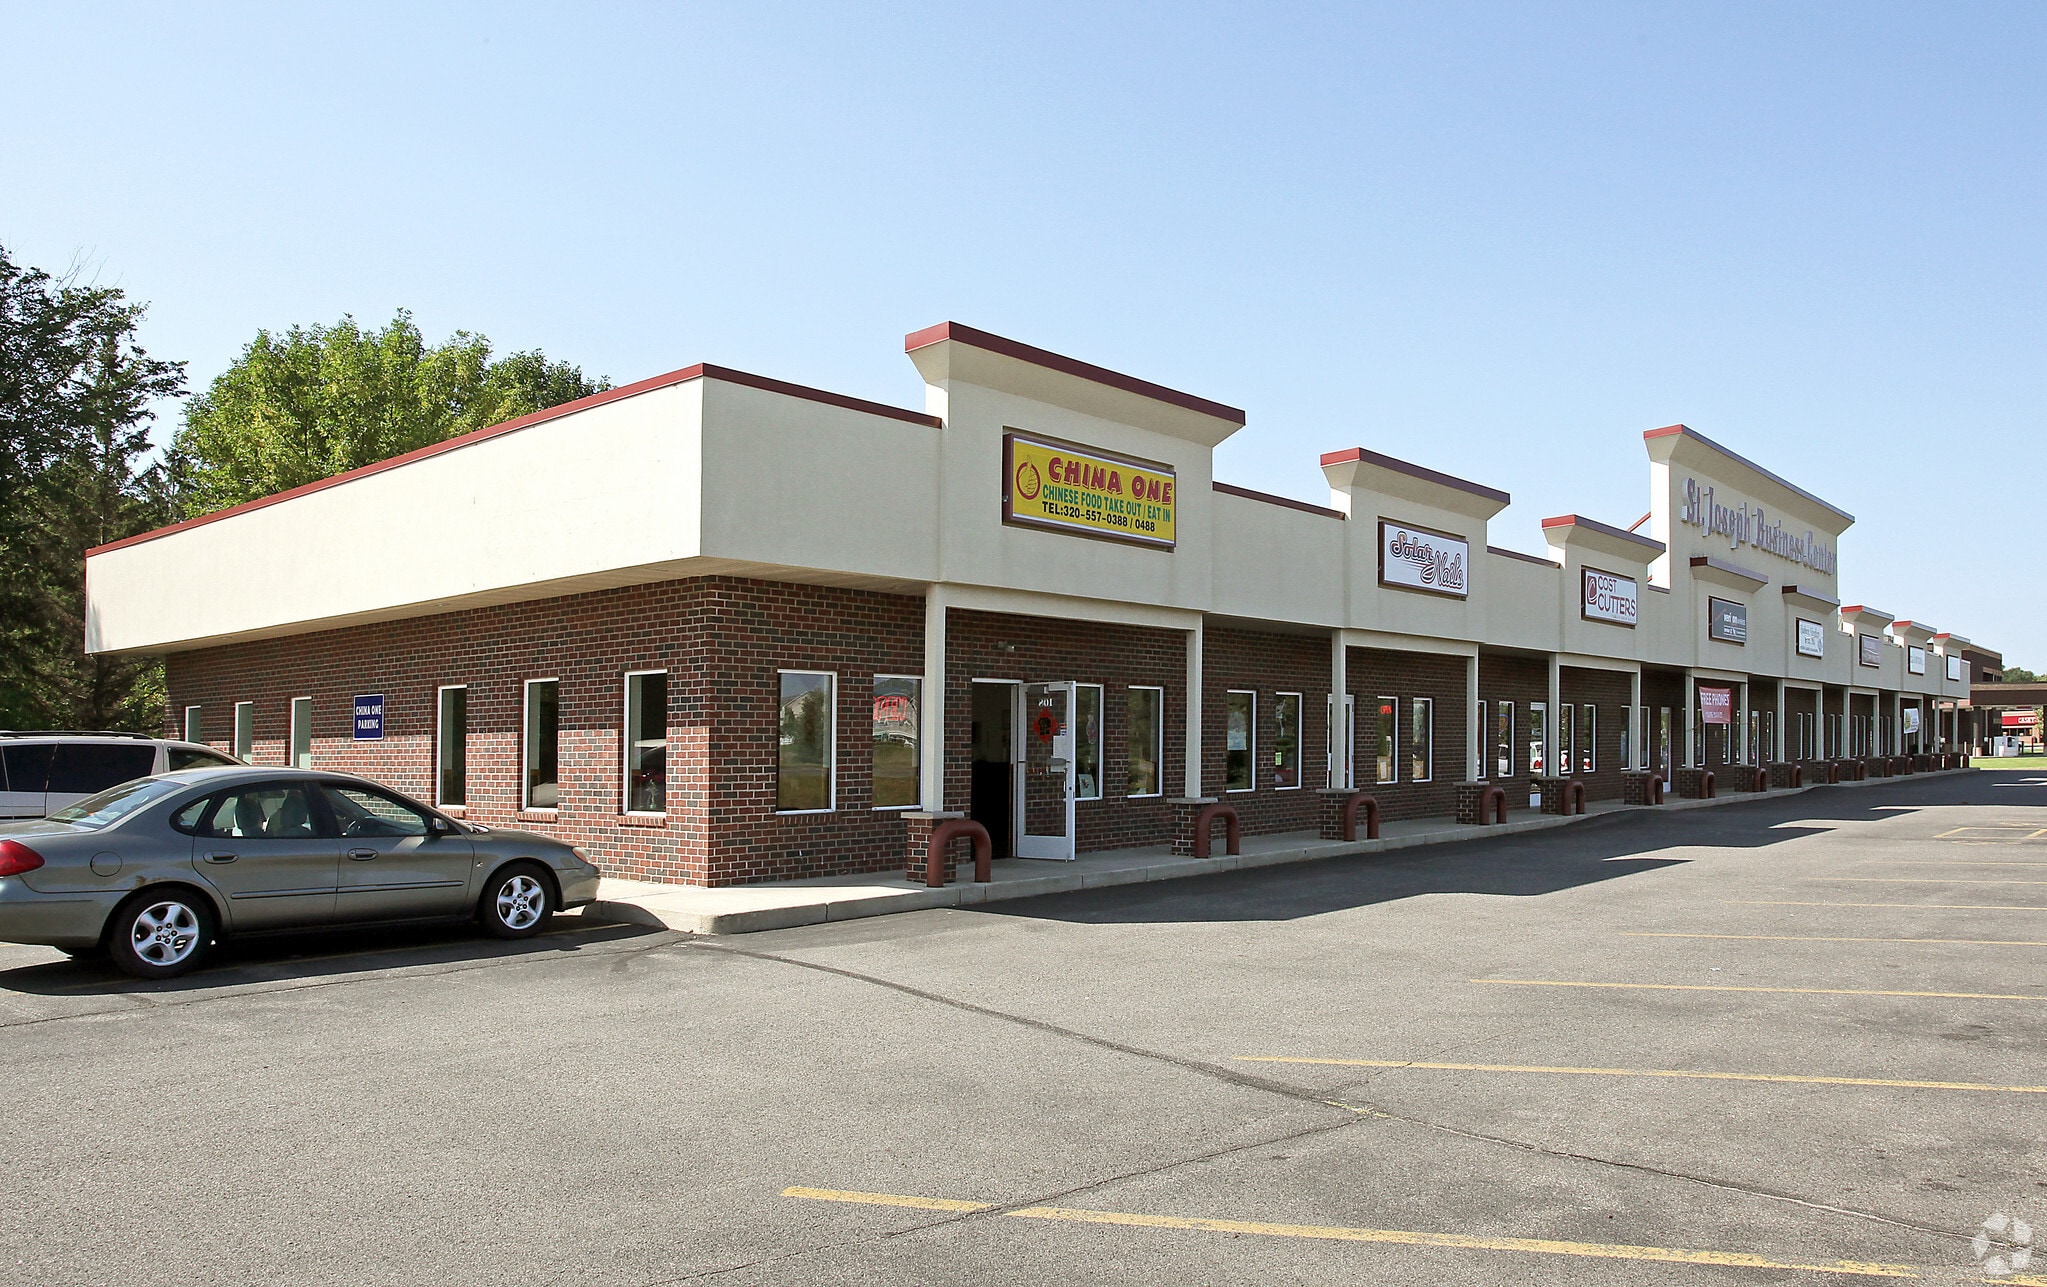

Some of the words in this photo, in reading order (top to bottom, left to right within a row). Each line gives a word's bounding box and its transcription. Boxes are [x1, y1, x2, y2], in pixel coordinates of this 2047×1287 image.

[1048, 457, 1123, 495] CHINA
[1132, 475, 1173, 505] ONE
[1042, 483, 1079, 505] CHINESE
[1081, 491, 1102, 509] FOOD
[1104, 497, 1124, 514] TAKE
[1126, 501, 1141, 516] OUT
[1147, 505, 1161, 520] EAT
[1163, 508, 1171, 522] IN
[1042, 501, 1128, 527] TEL:320-557-0388
[1135, 519, 1155, 532] 0488
[1682, 477, 1704, 525] St.
[1703, 486, 1750, 549] Joseph
[1751, 507, 1804, 562] Business
[1803, 530, 1836, 575] Center
[1390, 531, 1434, 562] Solar
[1433, 551, 1464, 589] Nails
[1598, 576, 1617, 593] COST
[1598, 593, 1636, 617] CUTTERS
[356, 705, 370, 716] CHINA
[371, 705, 381, 715] ONE
[1701, 693, 1711, 705] FREE
[1712, 693, 1730, 706] PHONES
[357, 719, 379, 729] PARKING
